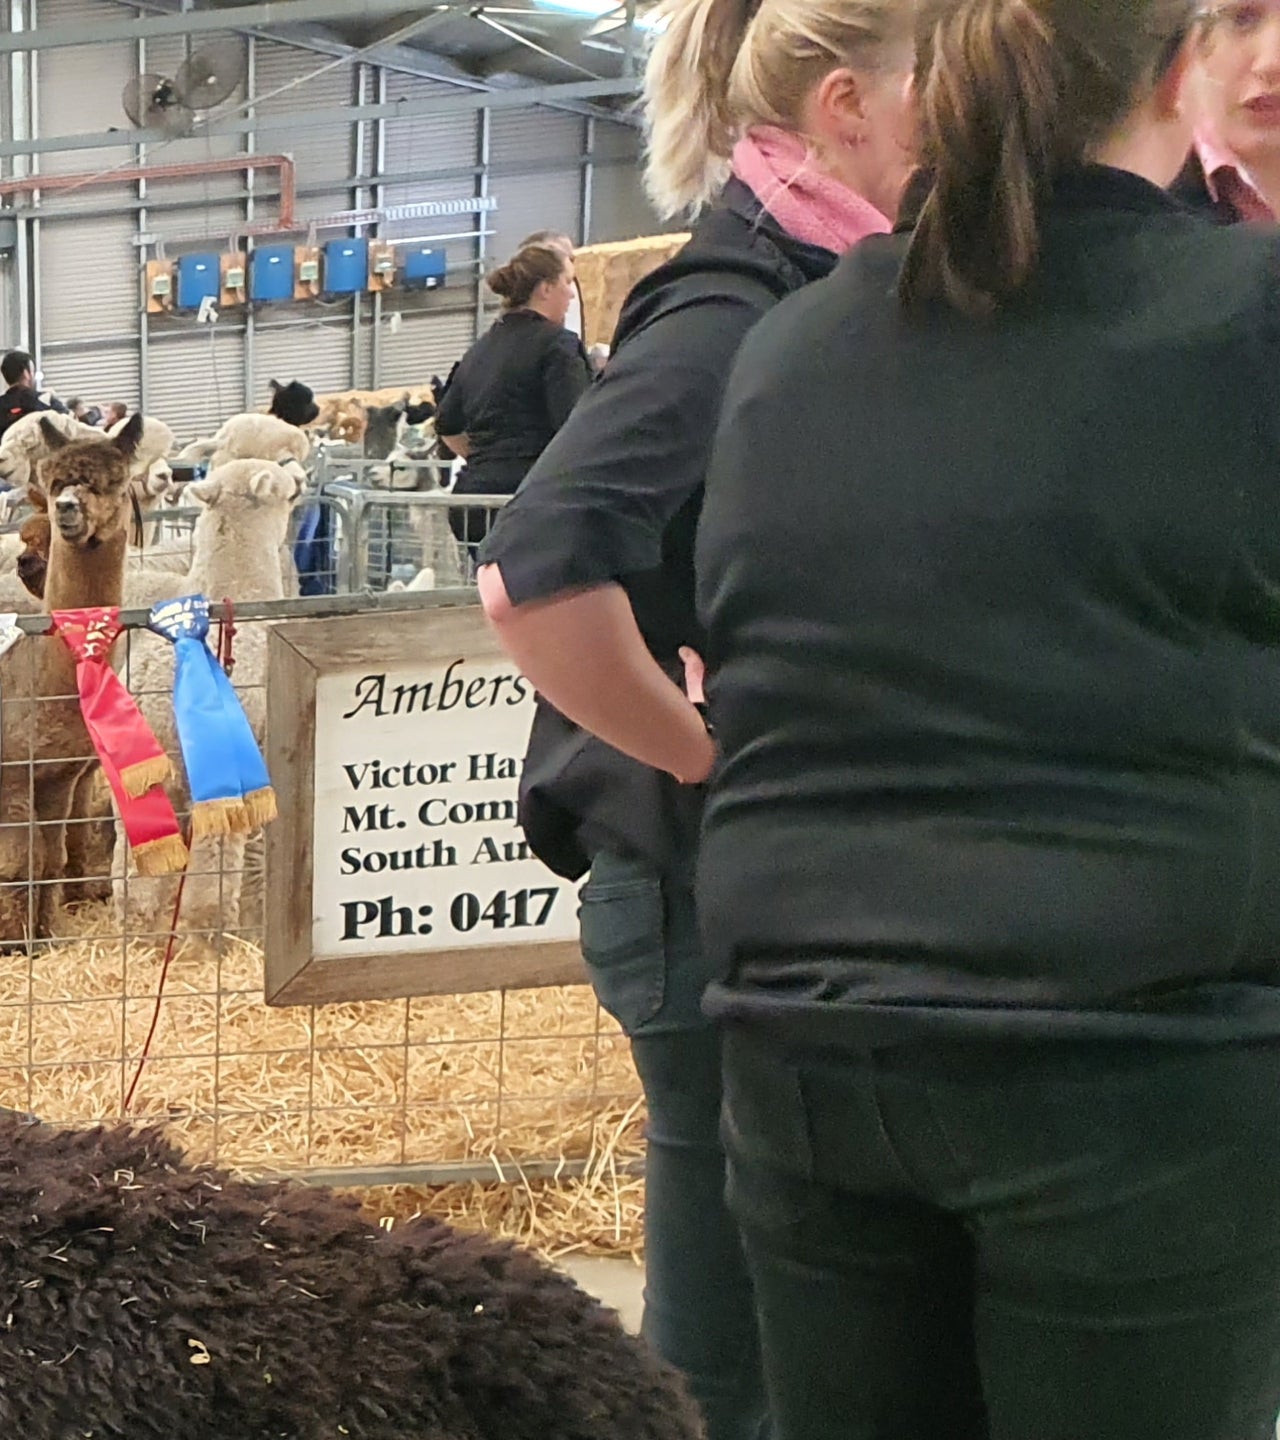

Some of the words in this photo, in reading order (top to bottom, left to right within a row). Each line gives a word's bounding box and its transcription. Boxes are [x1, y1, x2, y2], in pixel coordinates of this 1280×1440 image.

[343, 658, 539, 719] Ambers
[342, 760, 457, 790] Victor
[466, 753, 526, 781] Ha
[341, 803, 407, 834] Mt.
[340, 839, 458, 875] South
[469, 836, 537, 865] Au
[338, 895, 433, 941] Ph:
[450, 887, 560, 932] 0417
